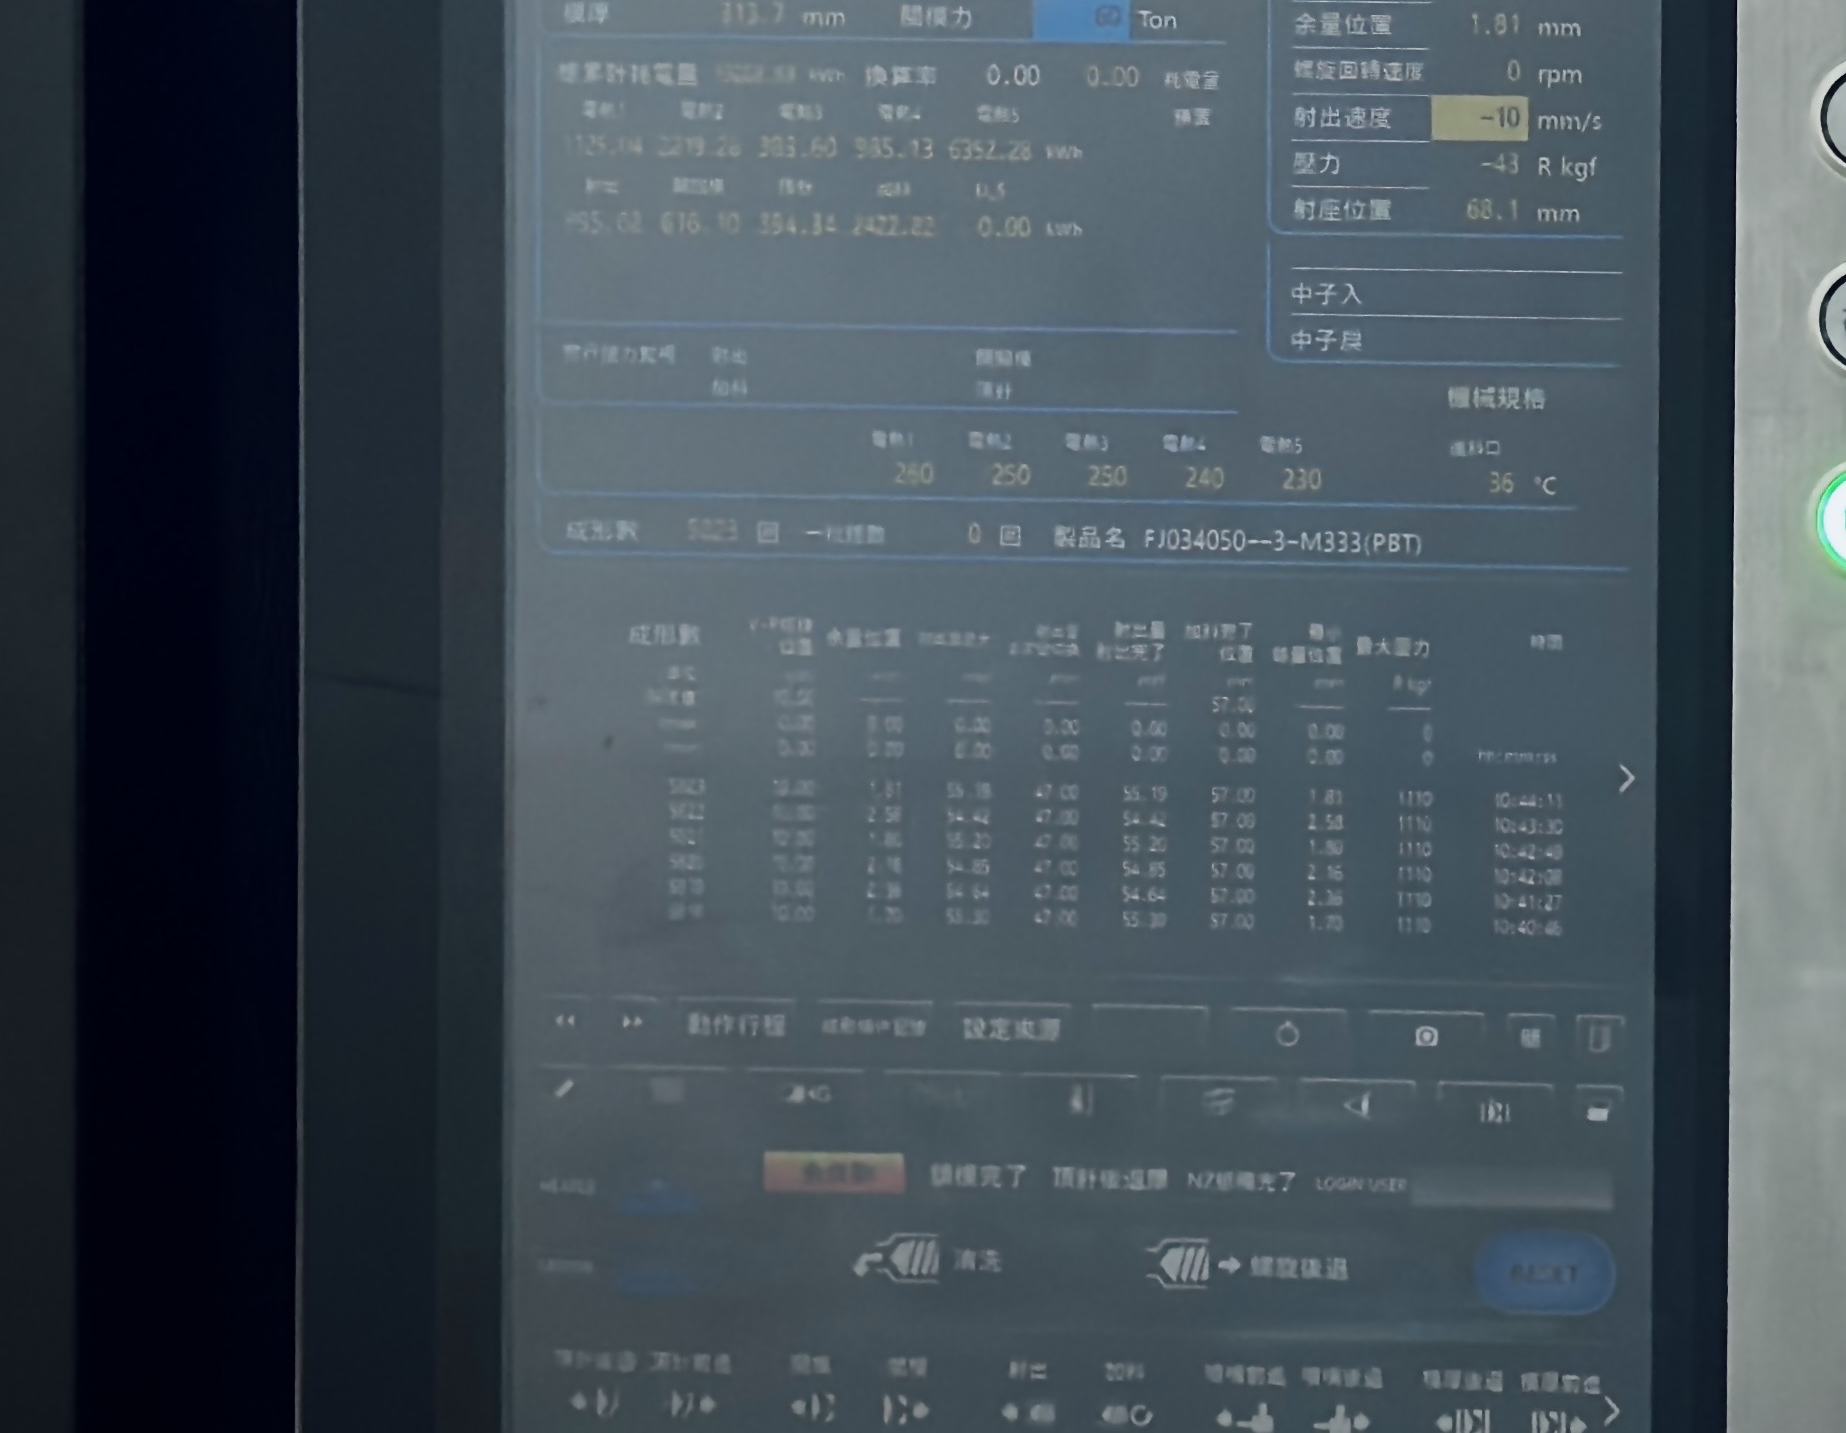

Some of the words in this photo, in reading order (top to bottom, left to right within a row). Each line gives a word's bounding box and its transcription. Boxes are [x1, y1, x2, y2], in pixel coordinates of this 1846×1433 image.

[801, 11, 847, 28] mm
[1136, 8, 1179, 31] Ton
[1470, 12, 1521, 37] 1.81
[1537, 21, 1583, 38] mm
[985, 63, 1041, 87] 0.00
[1505, 58, 1522, 83] 0
[1537, 67, 1583, 90] rpm
[1294, 106, 1393, 131] 射出速度
[1479, 106, 1521, 129] -10
[1537, 111, 1604, 133] mm/s
[1292, 151, 1342, 176] 壓力
[1537, 155, 1552, 177] R
[1559, 155, 1599, 183] kgf
[976, 215, 1033, 239] 0.00
[1536, 206, 1582, 224] mm
[1290, 282, 1364, 307] 中子入
[1185, 465, 1227, 490] 240
[1282, 467, 1323, 492] 230
[1488, 470, 1515, 495] 36
[967, 521, 982, 545] 0
[1054, 524, 1125, 550] 製品名
[1314, 1176, 1364, 1193] LOGIN
